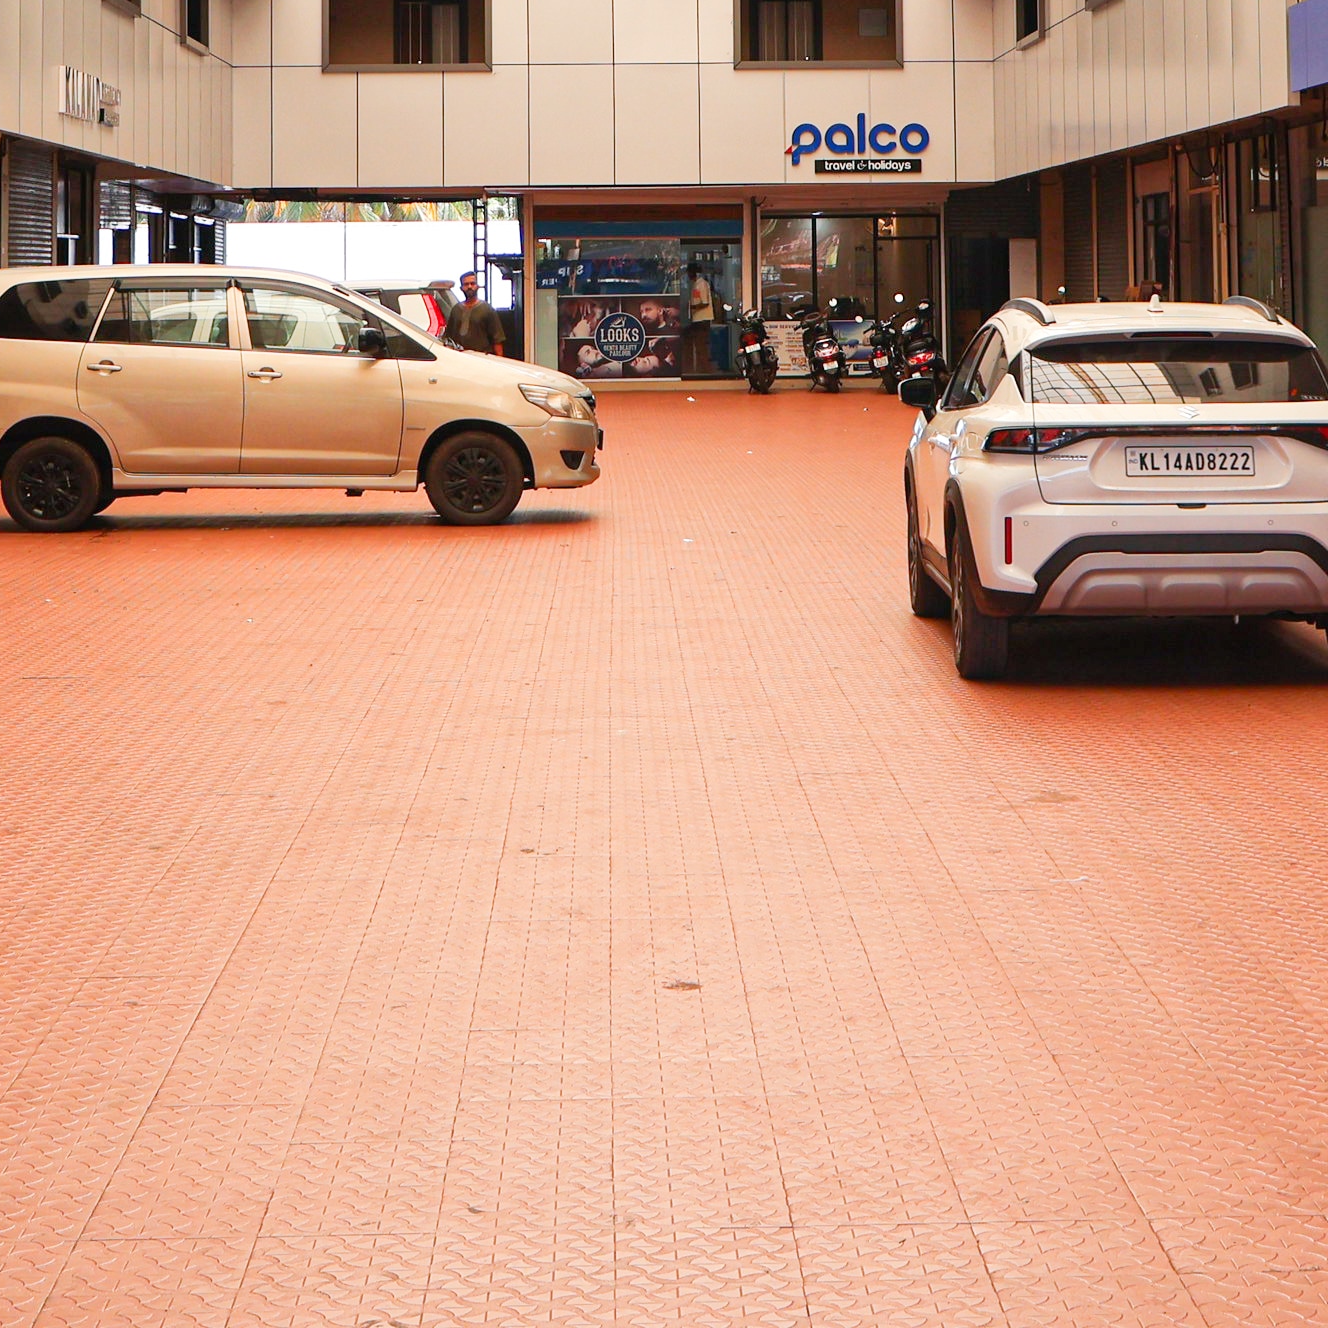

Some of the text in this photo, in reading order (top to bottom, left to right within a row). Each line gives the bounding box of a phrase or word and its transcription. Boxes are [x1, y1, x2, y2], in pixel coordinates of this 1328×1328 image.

[785, 112, 930, 166] palco
[824, 160, 855, 171] travel
[868, 160, 912, 172] holidays
[600, 328, 639, 342] LOOKS
[1139, 452, 1251, 471] KL14AD8222
